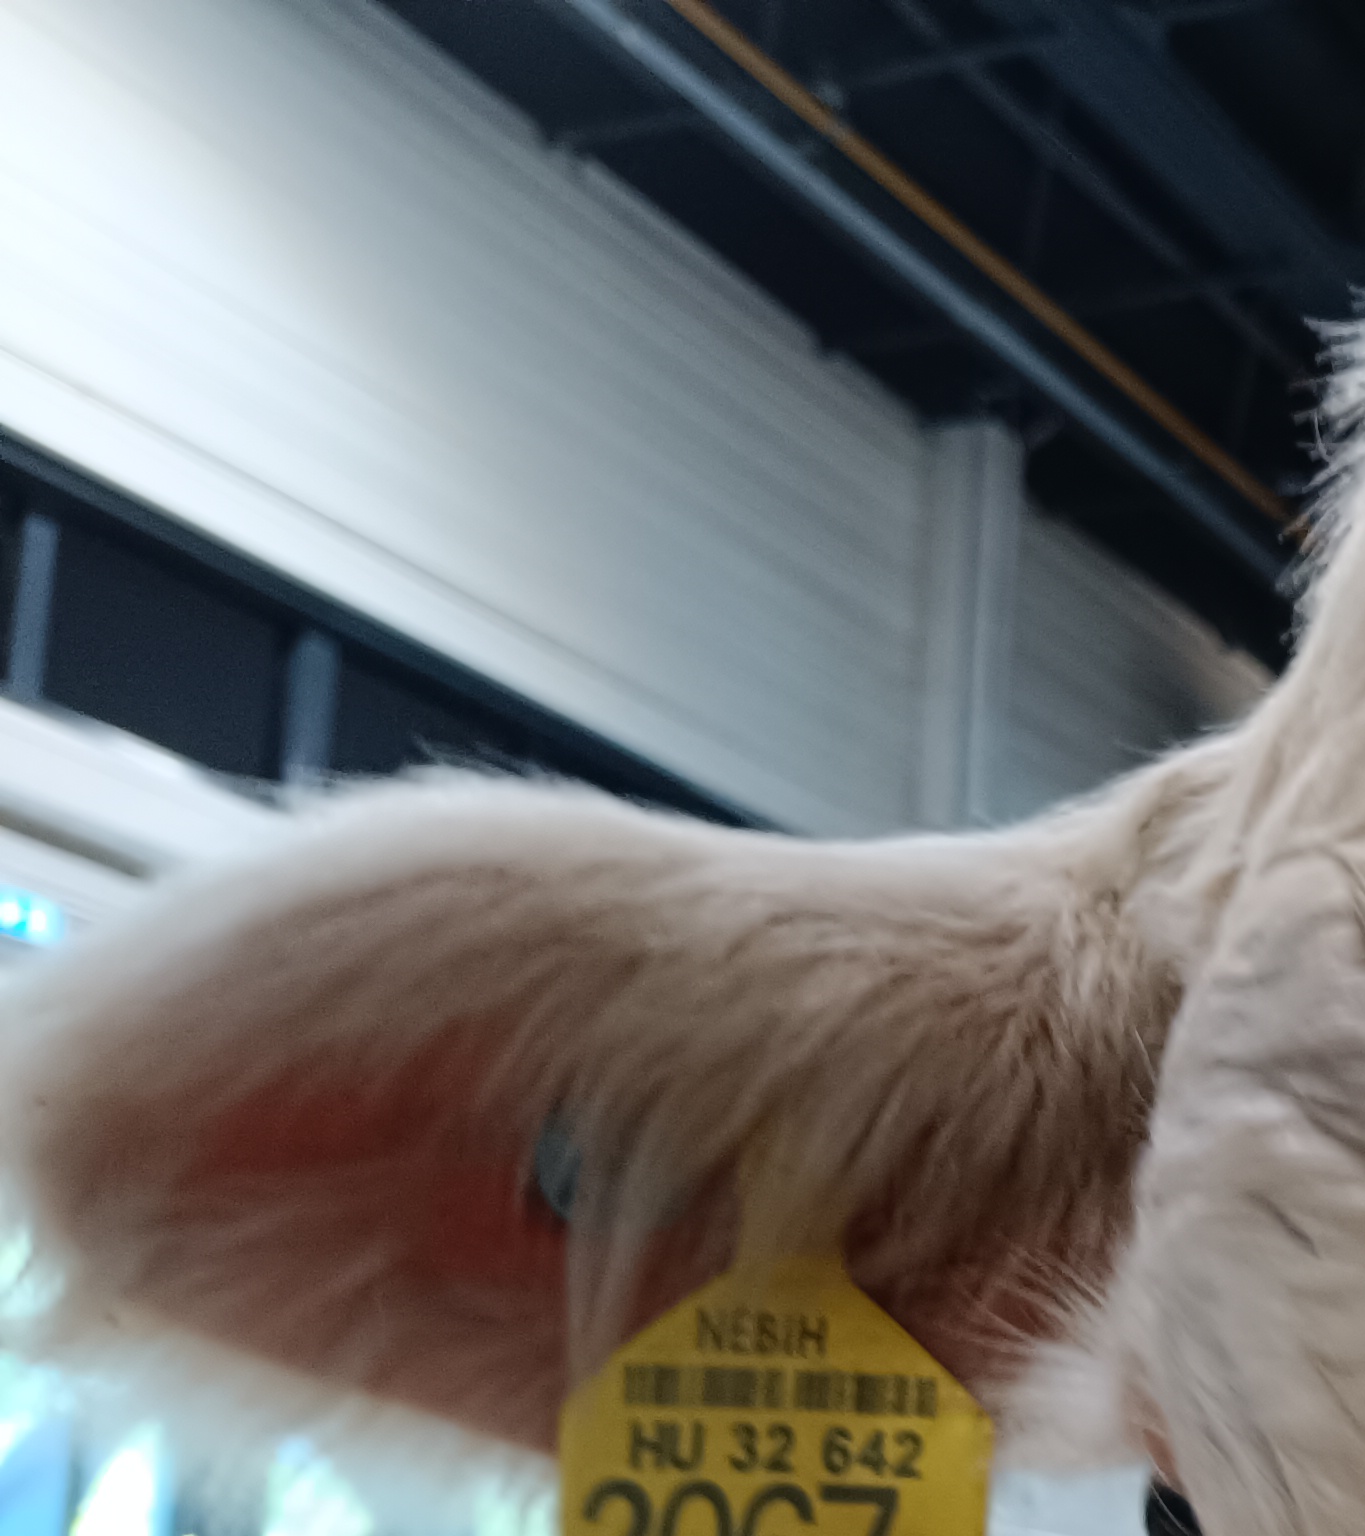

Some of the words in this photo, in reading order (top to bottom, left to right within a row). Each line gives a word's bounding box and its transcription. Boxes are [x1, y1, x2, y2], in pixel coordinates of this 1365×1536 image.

[629, 1420, 704, 1471] HU
[729, 1422, 796, 1474] 32
[821, 1425, 923, 1480] 642
